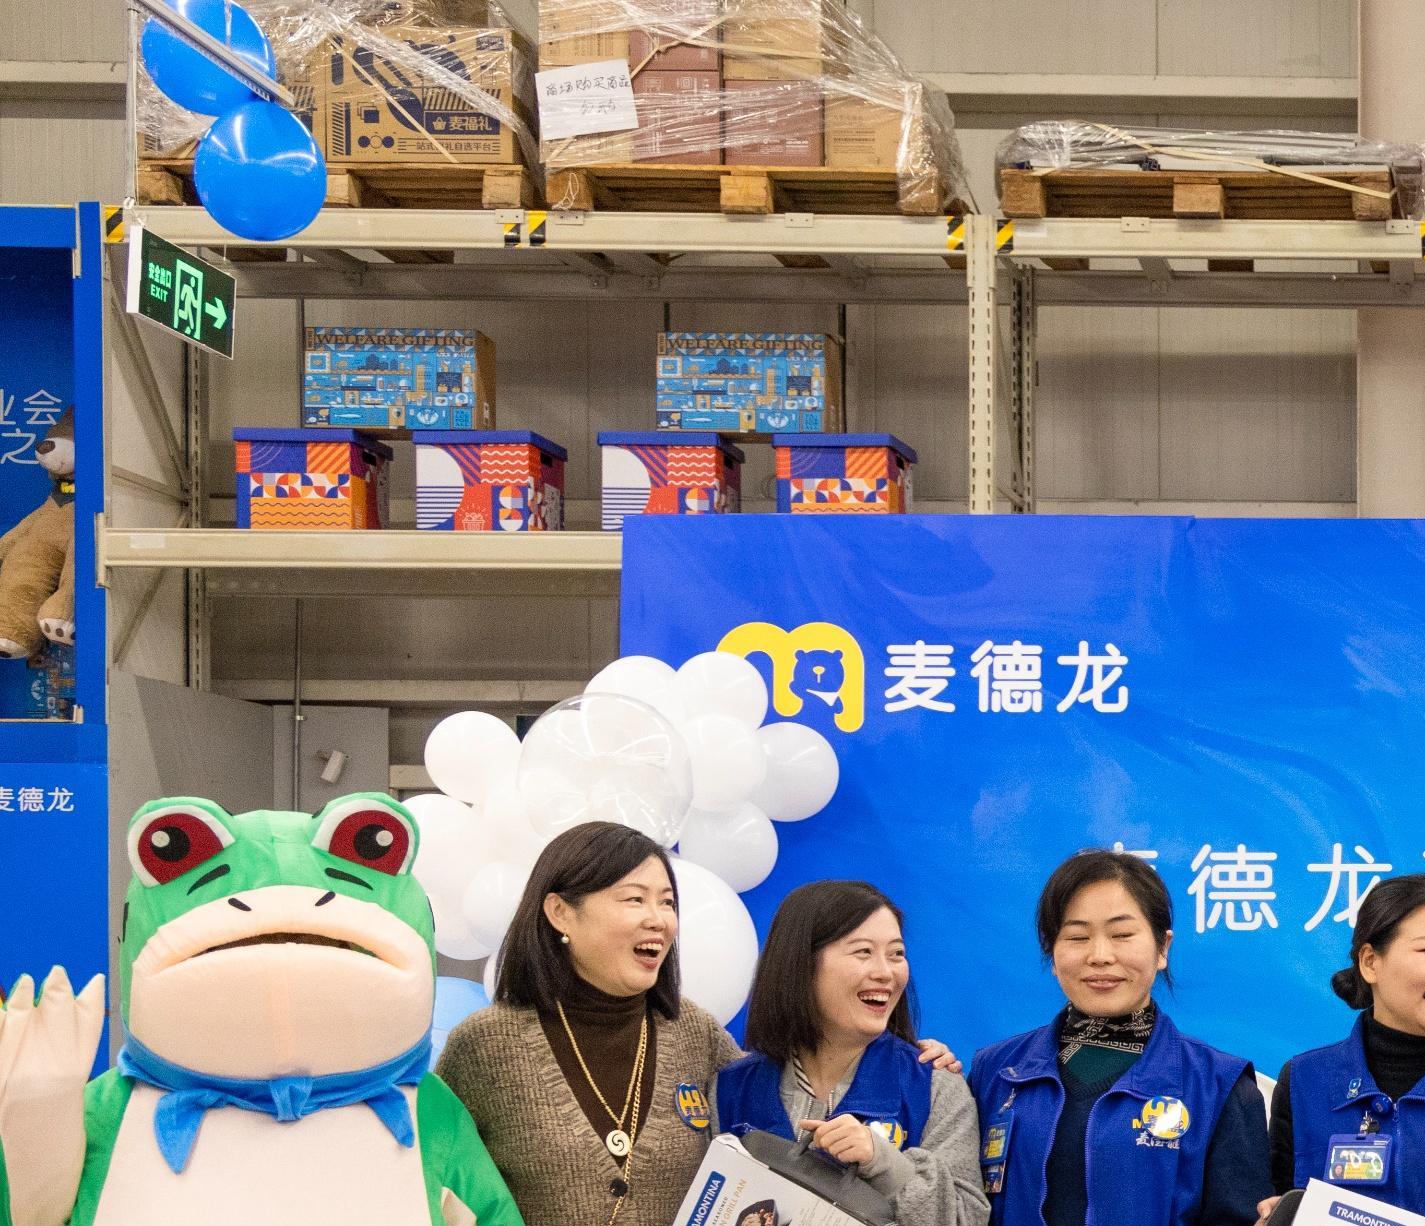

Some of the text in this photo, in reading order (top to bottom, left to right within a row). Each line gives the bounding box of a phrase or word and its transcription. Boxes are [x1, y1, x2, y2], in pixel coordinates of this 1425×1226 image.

[449, 116, 492, 131] 麦福礼
[149, 262, 172, 289] 安全出口
[150, 285, 169, 303] EXIT
[317, 334, 474, 347] WELFARE GIFTING
[667, 338, 823, 350] WELFARE GIFTING
[885, 640, 1129, 713] 麦德龙
[732, 1178, 747, 1198] PAN
